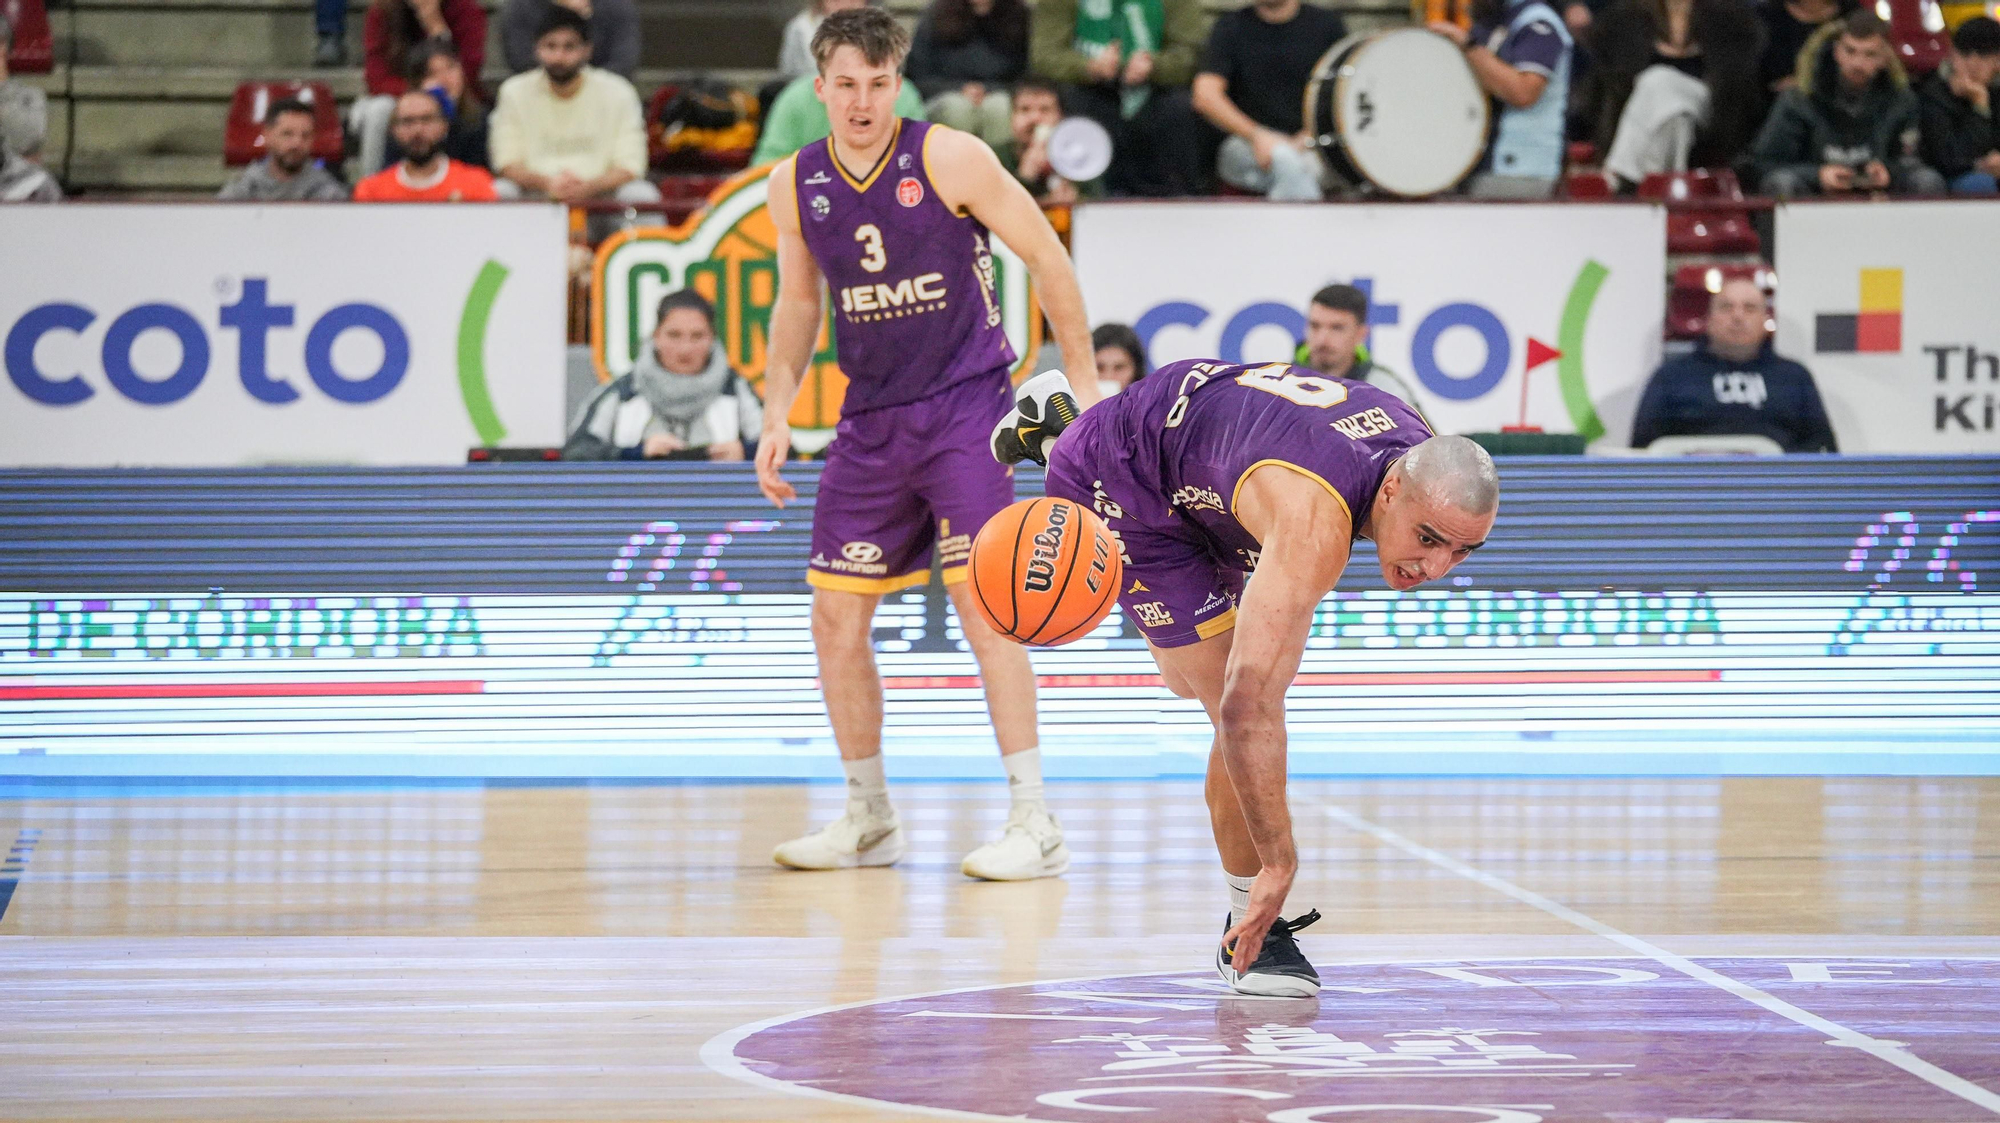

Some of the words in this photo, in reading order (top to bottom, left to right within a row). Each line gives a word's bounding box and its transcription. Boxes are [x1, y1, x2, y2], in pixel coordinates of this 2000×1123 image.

[855, 223, 887, 273] 3
[3, 277, 411, 406] coto
[1934, 394, 2000, 431] Ki
[1024, 502, 1071, 593] Wilson
[1132, 601, 1171, 621] CBC
